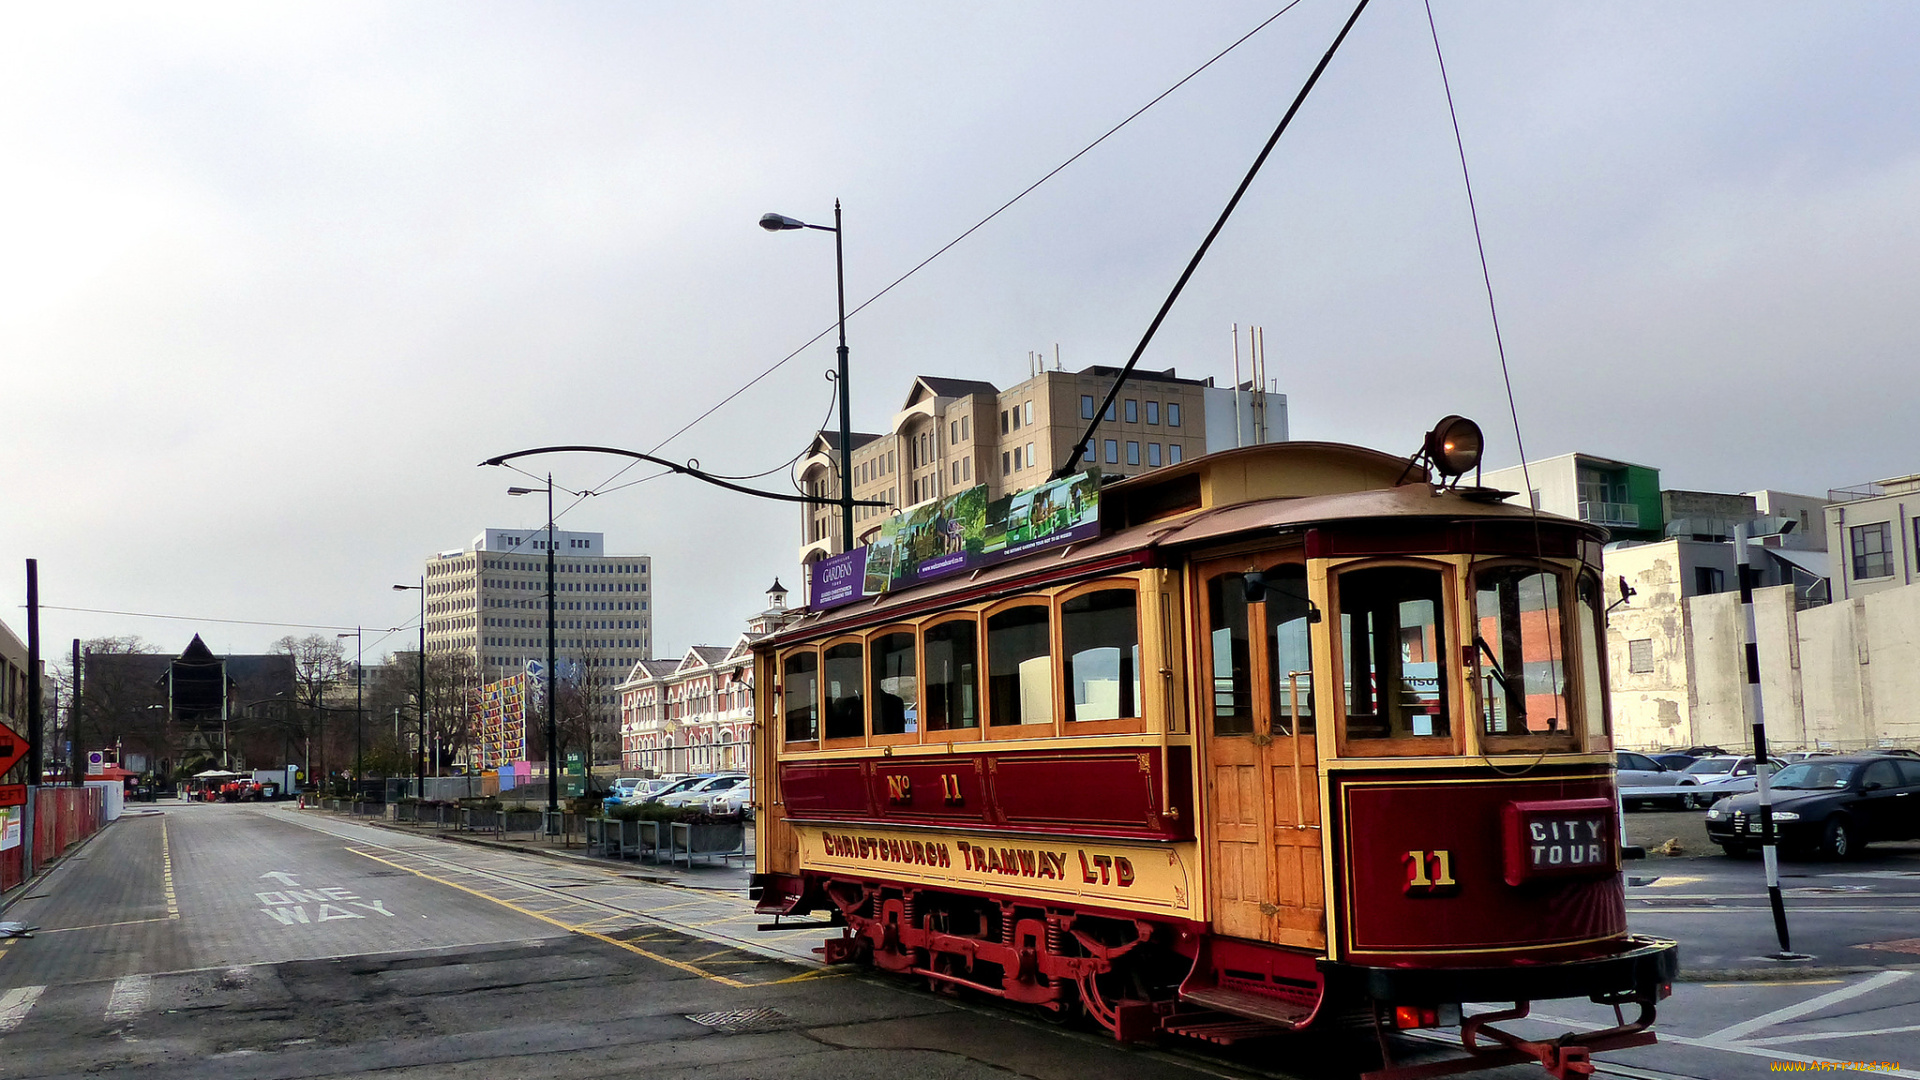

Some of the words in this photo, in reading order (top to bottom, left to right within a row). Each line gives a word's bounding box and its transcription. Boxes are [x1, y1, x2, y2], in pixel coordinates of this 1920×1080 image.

[822, 561, 853, 584] GARDENS
[0, 789, 23, 801] EFT
[941, 774, 962, 799] 11
[1530, 820, 1601, 841] CITY
[822, 831, 950, 868] CHRISTCHURCH
[957, 841, 1067, 880] TRAMWAY
[1531, 844, 1601, 865] TOUR
[1404, 850, 1456, 888] 11
[254, 887, 361, 906] ONE
[260, 900, 395, 926] WAY
